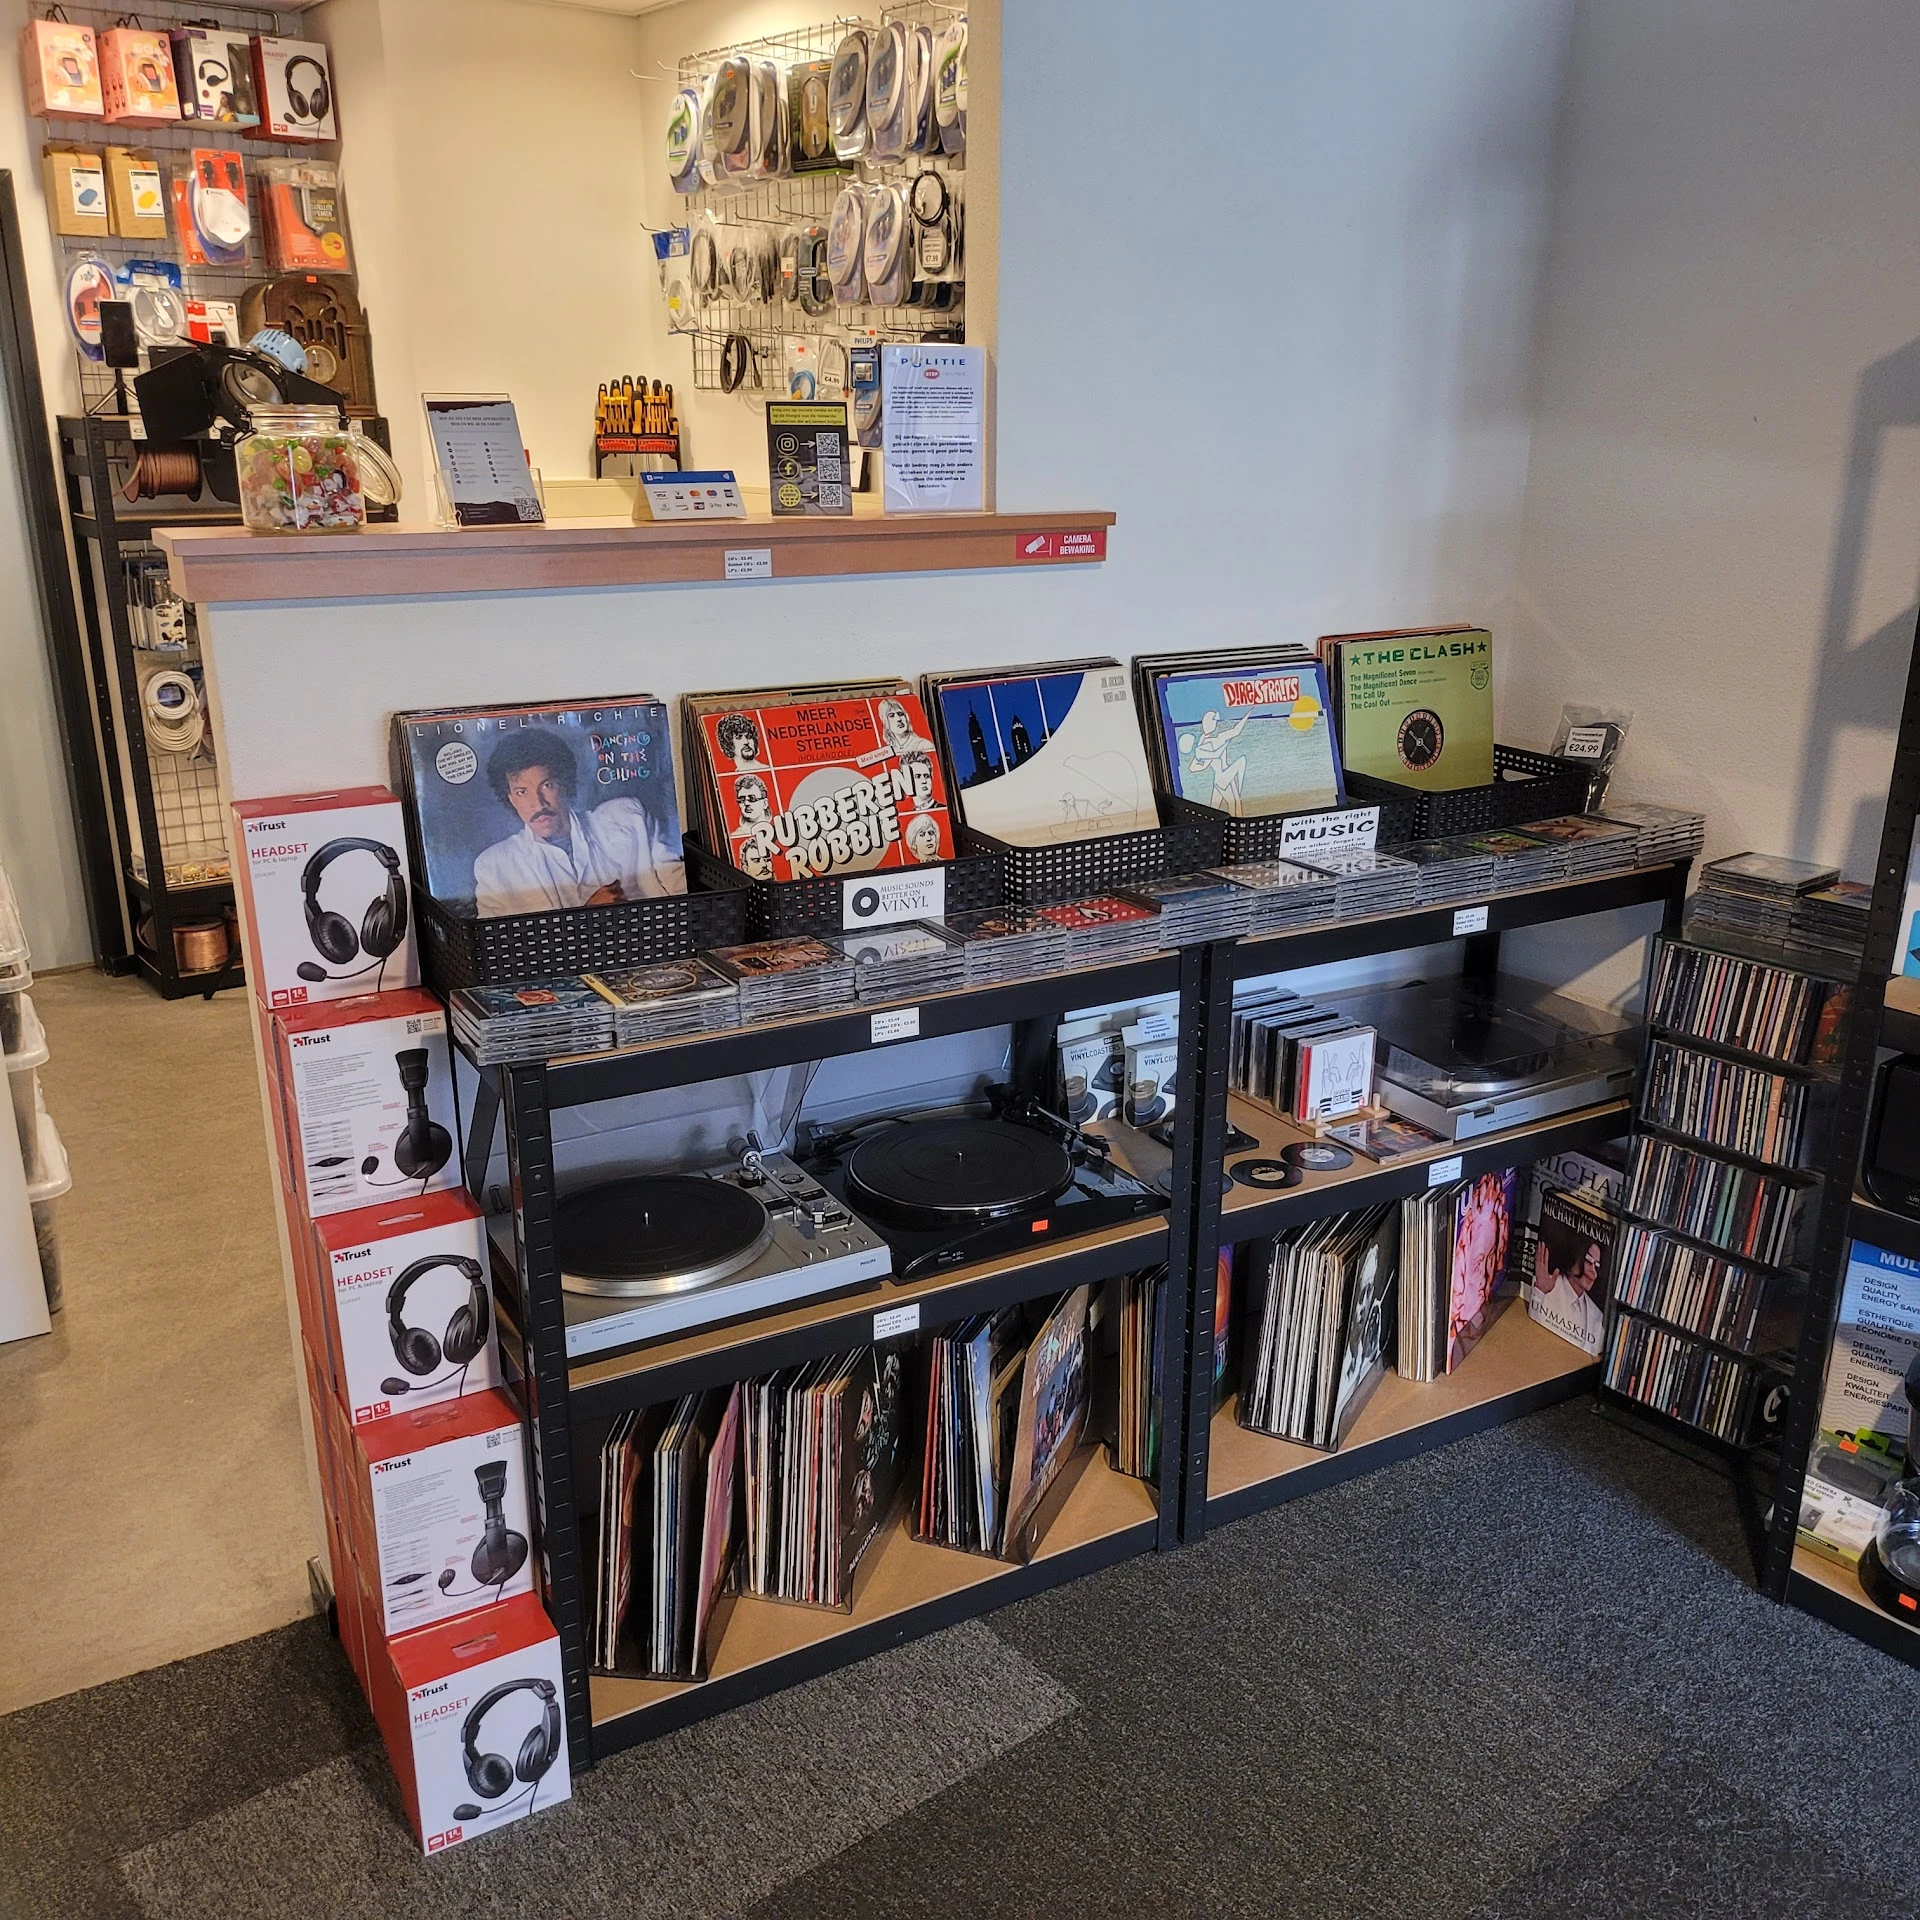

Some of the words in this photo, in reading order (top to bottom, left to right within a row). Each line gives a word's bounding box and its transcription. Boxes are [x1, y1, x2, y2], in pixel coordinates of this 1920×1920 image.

[926, 254, 938, 262] €7.99
[1063, 534, 1092, 544] CAMERA
[1059, 544, 1095, 555] BEWAKING
[1409, 642, 1475, 661] CLASH
[1350, 674, 1361, 682] The
[1363, 670, 1398, 681] Magnificent
[1398, 669, 1417, 677] Seven
[1350, 683, 1361, 691] The
[1363, 679, 1398, 691] Magnificent
[1399, 678, 1417, 686] Dance
[1350, 693, 1362, 701] The
[1363, 691, 1375, 699] Call
[1377, 690, 1386, 699] Up
[1351, 702, 1362, 710] The
[1363, 700, 1378, 709] Cool
[1379, 699, 1391, 707] Out
[796, 707, 837, 722] MEER
[415, 717, 527, 737] LIONEL
[557, 708, 658, 725] RICHIE
[767, 717, 873, 741] NEDERLANDSE
[589, 731, 651, 751] DANCING
[796, 735, 851, 752] STERRE
[1569, 743, 1599, 753] €24.99
[598, 751, 615, 764] ON
[620, 747, 648, 763] THE
[596, 767, 650, 785] CEILING
[750, 764, 916, 857] RUBBEREN
[259, 821, 286, 831] Trust
[1291, 818, 1316, 827] with
[1321, 815, 1340, 825] the
[1345, 811, 1372, 820] right
[1284, 820, 1375, 843] MUSIC
[251, 843, 309, 859] HEADSET
[785, 805, 901, 882] ROBBIE
[1289, 847, 1327, 857] remember
[1329, 842, 1366, 850] everything
[880, 884, 904, 893] MUSIC
[904, 880, 934, 890] SOUNDS
[881, 891, 908, 900] BETTER
[909, 889, 921, 897] ON
[881, 896, 929, 912] VINYL
[302, 1034, 331, 1046] Trust
[1542, 1202, 1576, 1229] MICHAEL
[1576, 1220, 1610, 1247] JACKSON
[342, 1248, 372, 1261] Trust
[860, 1258, 877, 1266] PHILIPS
[1880, 1251, 1920, 1272] MUL
[337, 1266, 394, 1287] HEADSET
[1864, 1277, 1898, 1291] DESIGN
[1862, 1285, 1901, 1300] QUALITY
[1861, 1293, 1898, 1308] ENERGY
[1531, 1300, 1596, 1344] UNMASKED
[1857, 1317, 1895, 1332] QUALITE
[1859, 1309, 1914, 1330] ESTHETIQUE
[1856, 1325, 1902, 1343] ECONOMIE
[1853, 1340, 1886, 1356] DESIGN
[1851, 1349, 1893, 1366] QUALITAT
[1850, 1357, 1905, 1378] ENERGIESPA
[1847, 1373, 1880, 1388] DESIGN
[1845, 1381, 1890, 1399] KWALITEIT
[1843, 1389, 1909, 1415] ENERGIESPARE
[383, 1457, 412, 1472] Trust
[1814, 1483, 1837, 1496] CAMERA
[1816, 1488, 1835, 1499] system
[420, 1682, 448, 1697] Trust
[414, 1696, 470, 1724] HEADSET
